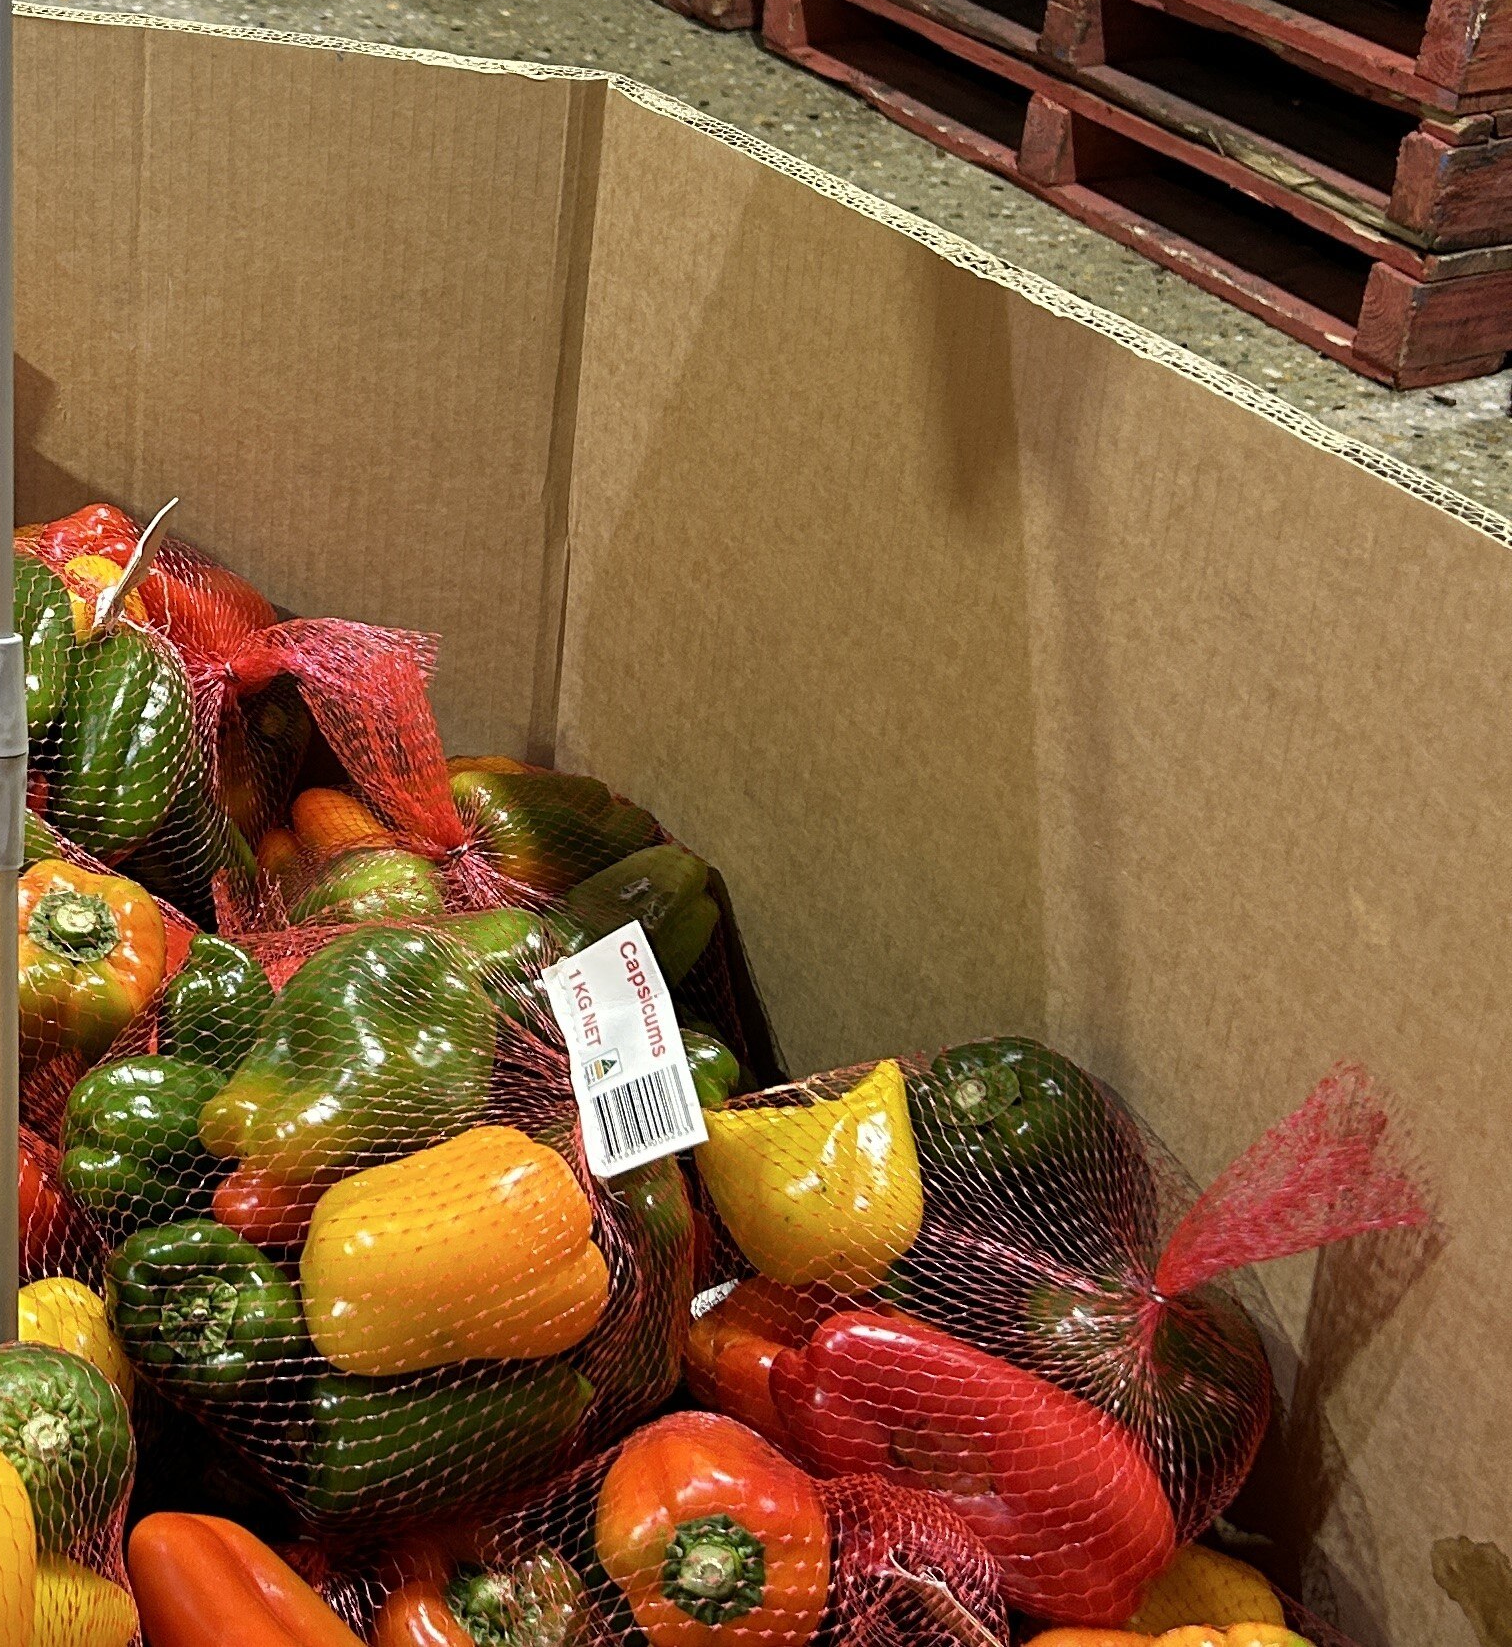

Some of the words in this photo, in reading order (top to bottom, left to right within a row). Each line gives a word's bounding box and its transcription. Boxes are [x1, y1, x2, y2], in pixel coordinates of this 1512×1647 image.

[568, 968, 582, 980] 1
[572, 981, 594, 1013] KG
[619, 940, 667, 1059] Capsicums
[581, 1012, 602, 1048] NET
